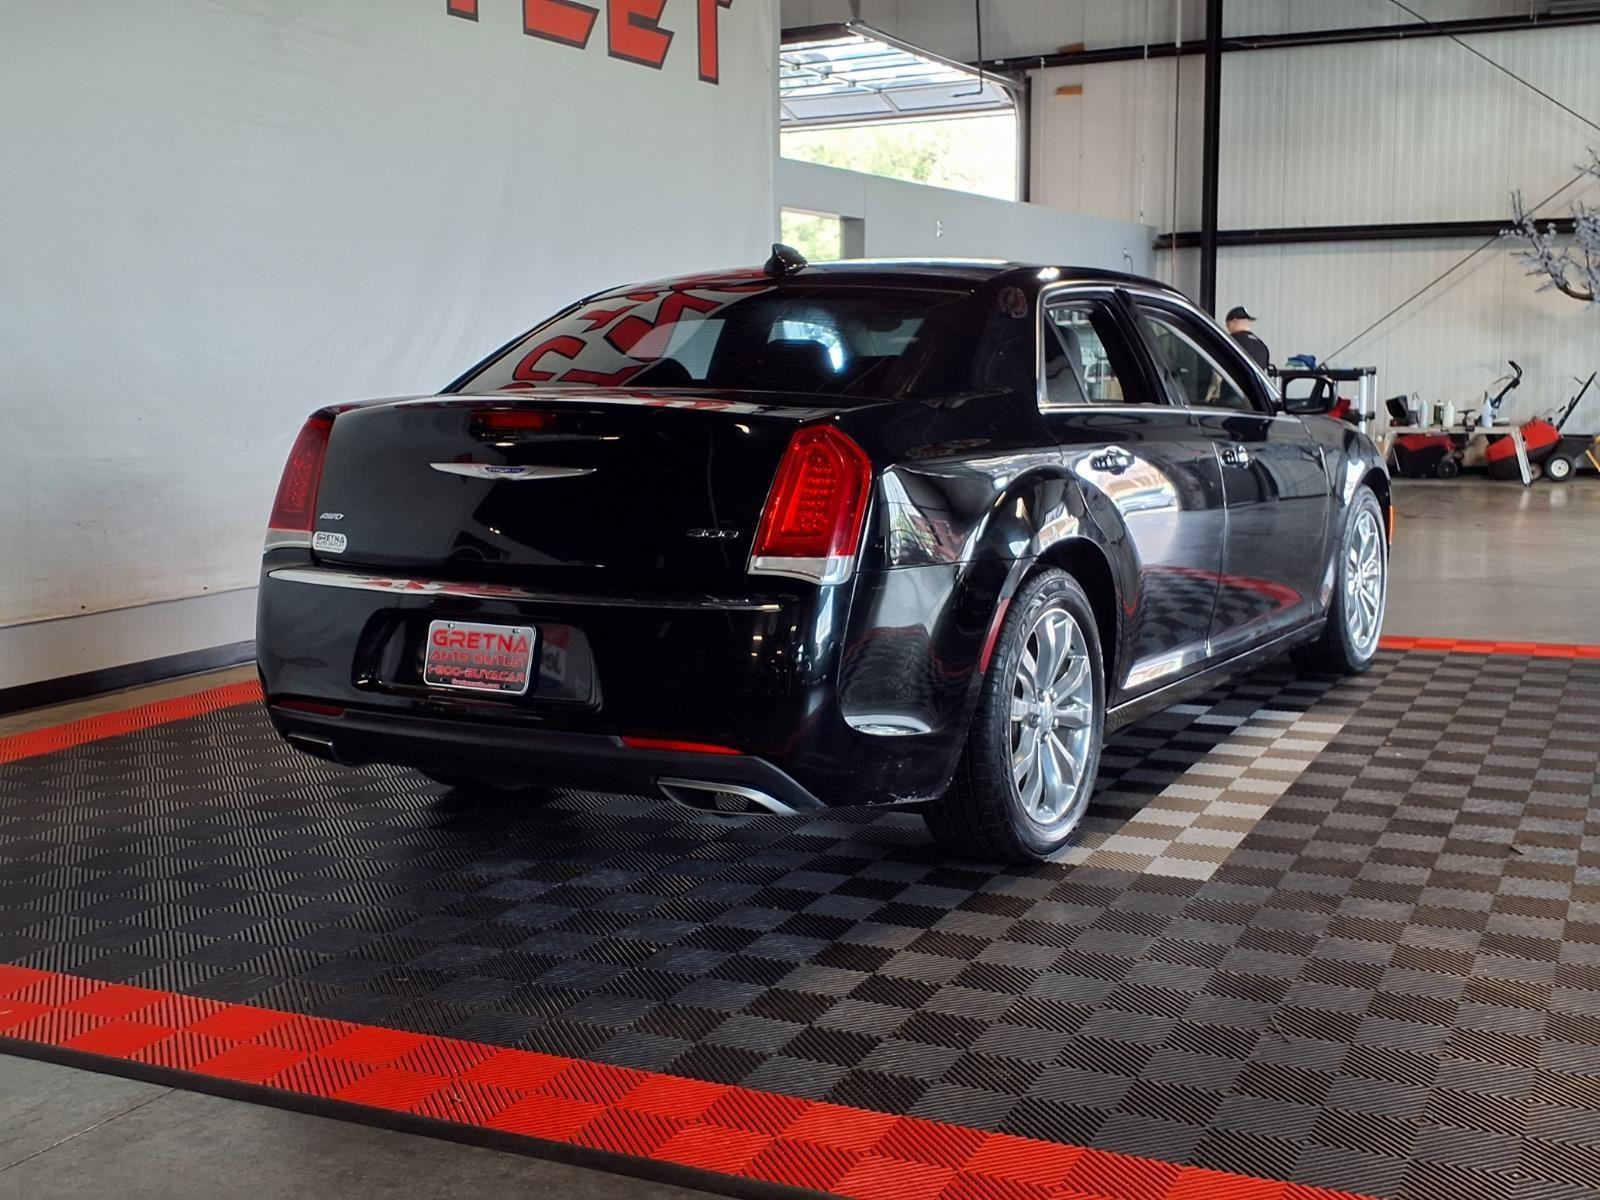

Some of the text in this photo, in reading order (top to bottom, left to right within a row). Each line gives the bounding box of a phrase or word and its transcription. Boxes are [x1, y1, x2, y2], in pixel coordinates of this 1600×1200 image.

[319, 512, 344, 520] AWD
[317, 533, 345, 543] GRETNA
[432, 629, 529, 653] GRETNA
[431, 650, 528, 668] AUTO OUTLET
